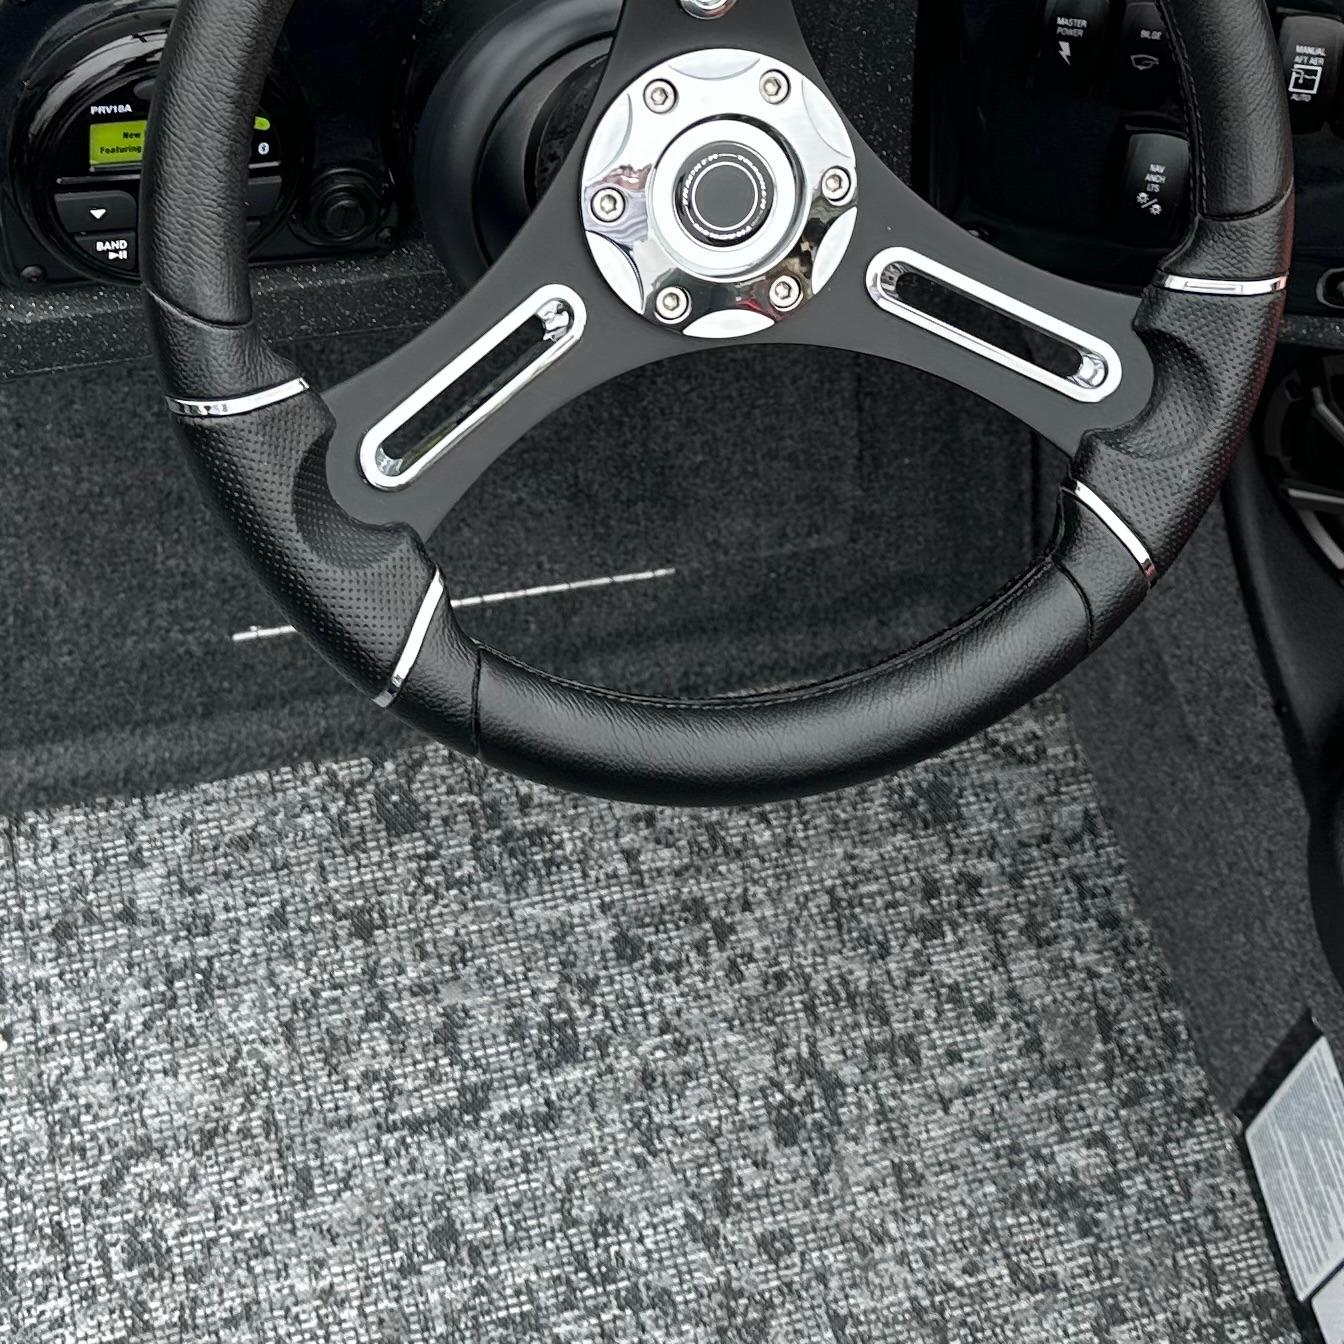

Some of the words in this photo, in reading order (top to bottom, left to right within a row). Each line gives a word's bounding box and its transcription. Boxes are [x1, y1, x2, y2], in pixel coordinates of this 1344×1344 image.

[1056, 16, 1088, 28] MASTER
[1056, 26, 1084, 38] POWER
[96, 239, 128, 252] BAND
